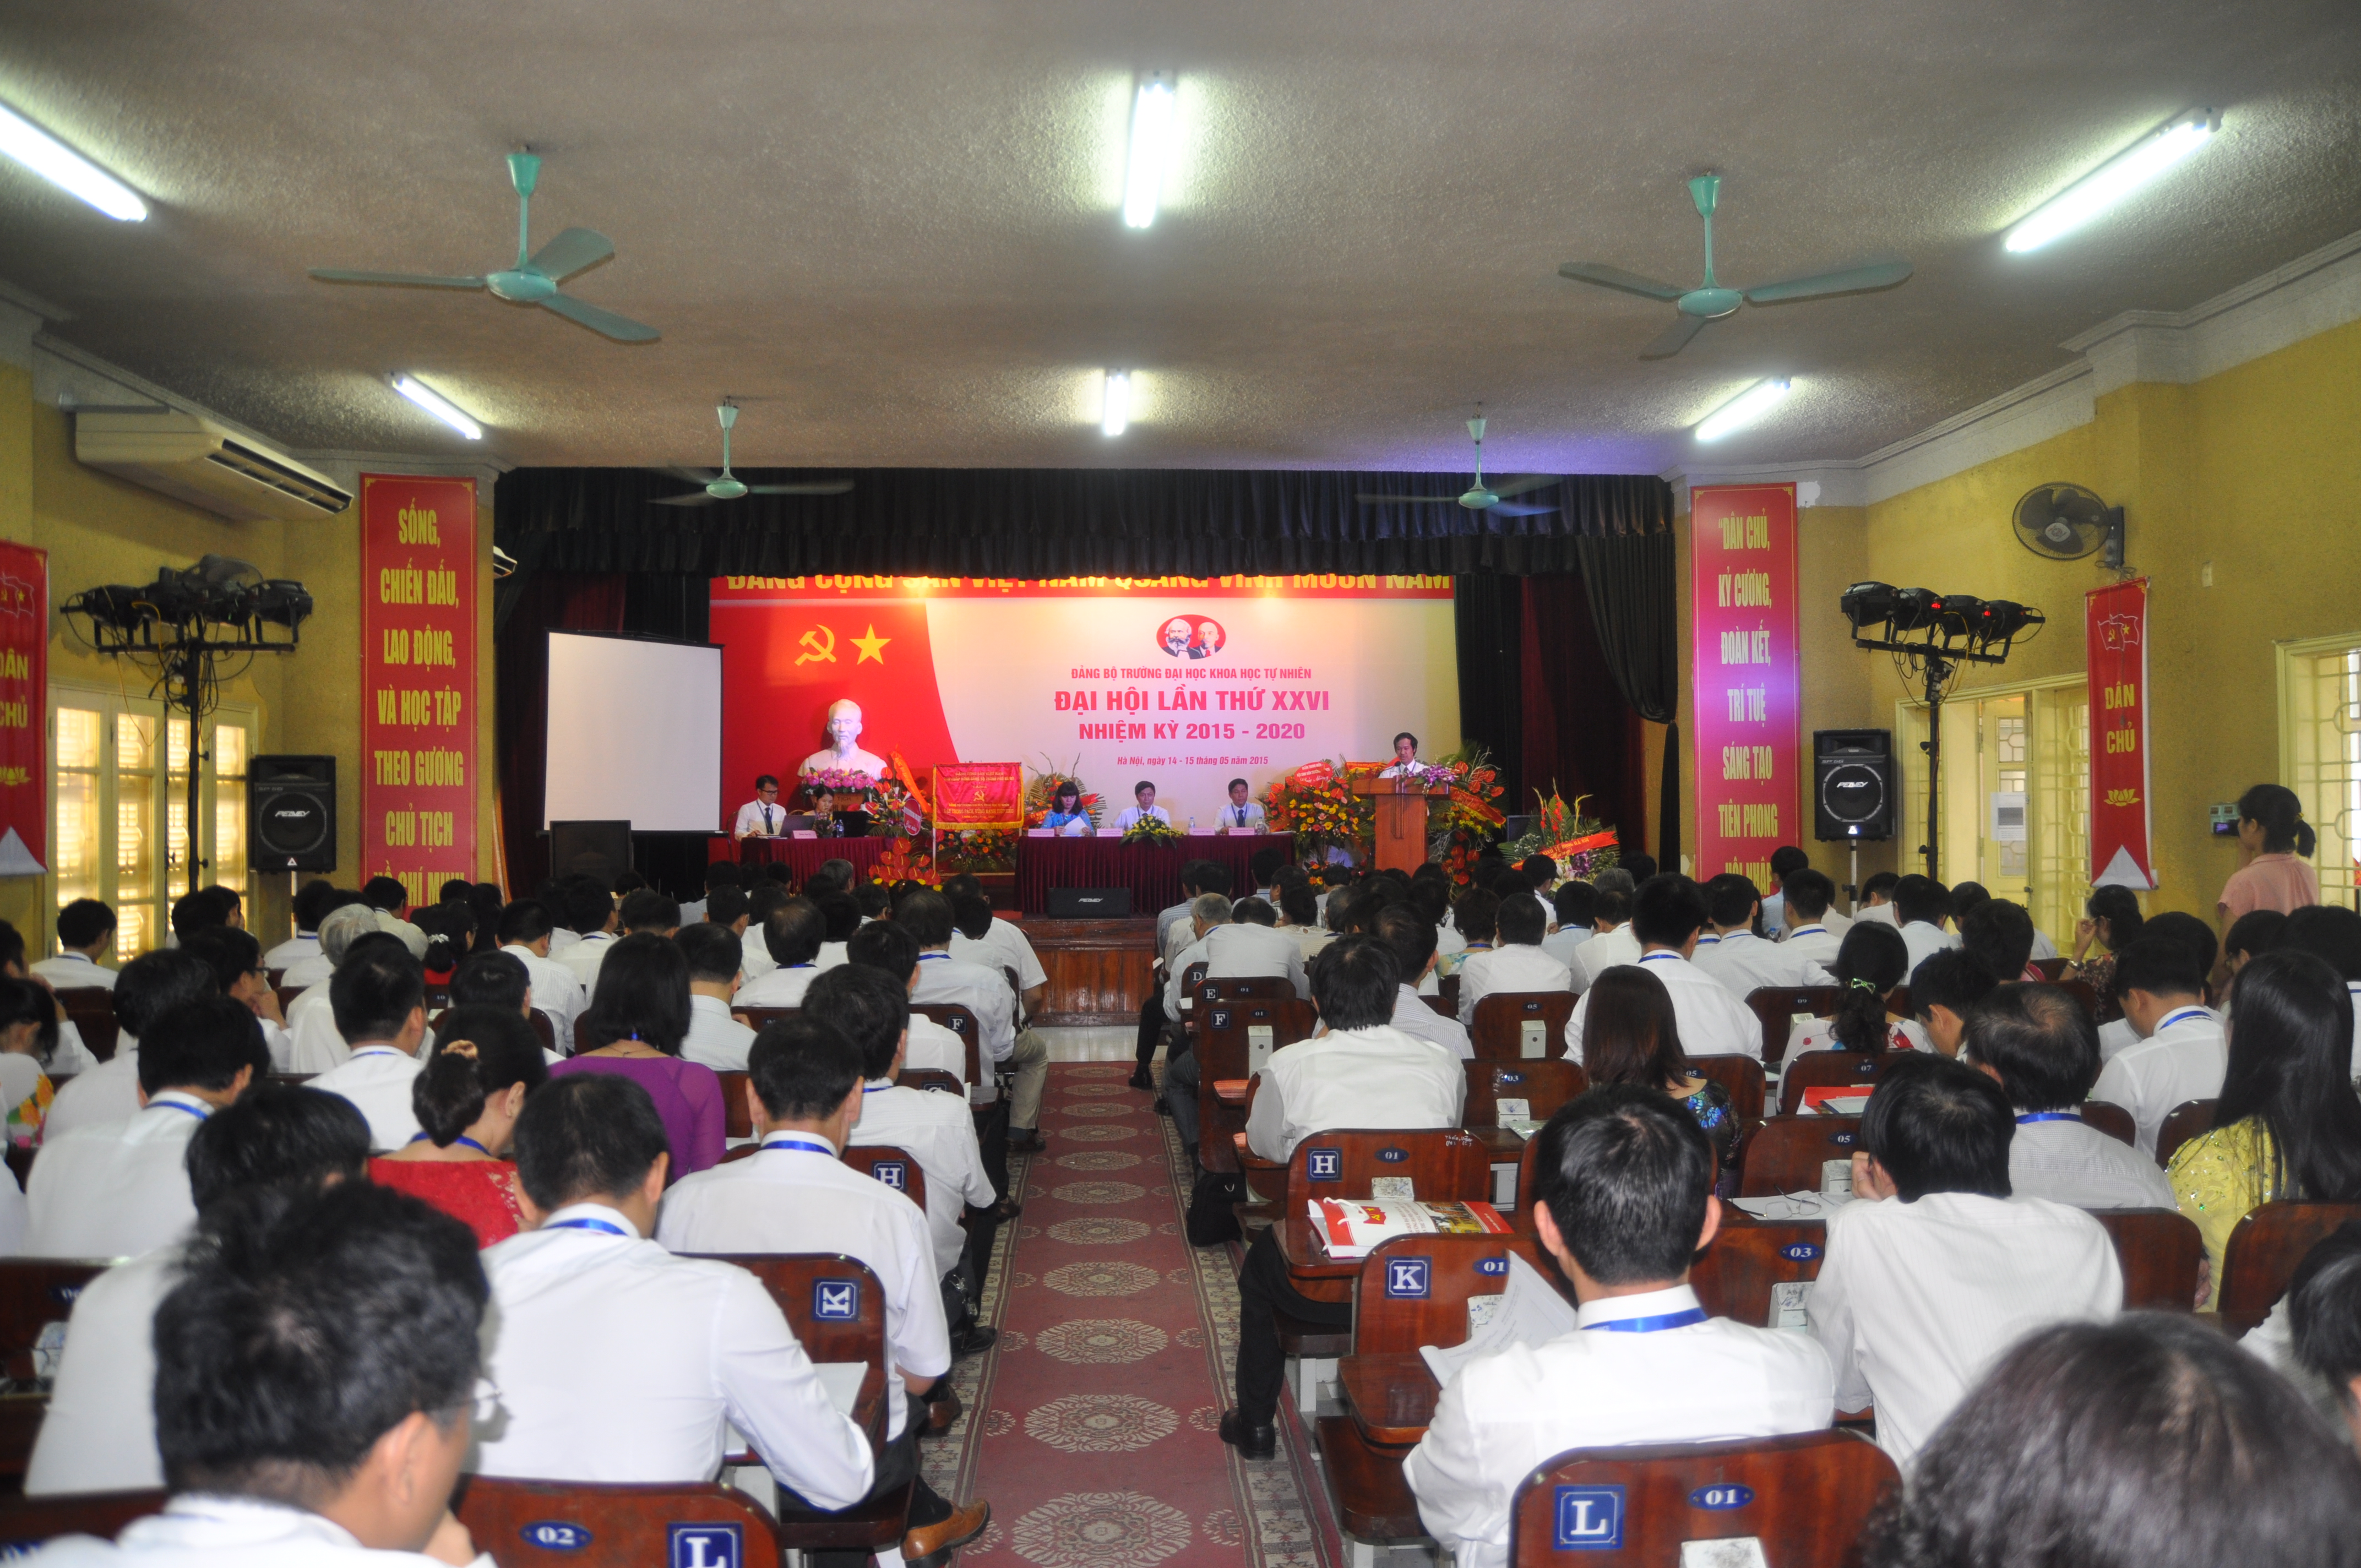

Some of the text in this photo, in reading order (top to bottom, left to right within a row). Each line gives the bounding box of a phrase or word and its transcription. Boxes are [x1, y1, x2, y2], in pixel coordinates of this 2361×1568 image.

[399, 498, 440, 548] SỐNG,
[1746, 508, 1770, 551] CHỦ,
[380, 558, 459, 608] CHIẾN ĐẤU,
[1718, 566, 1771, 609] KỶ CƯƠNG,
[384, 624, 455, 672] LAO ĐỘNG,
[1721, 619, 1771, 666] ĐOÀN KẾT,
[1071, 665, 1312, 681] ĐẢNG BỘ TRƯỜNG ĐẠI HỌC KHOA HỌC TỰ NHIÊN
[377, 684, 461, 732] VÀ HỌC TẬP
[1054, 684, 1329, 715] ĐẠI HỘI LẦN THỨ XXVI
[1727, 683, 1766, 727] TRÍ TUỆ
[2105, 681, 2135, 709] DÂN
[1079, 720, 1146, 743] NHIỆM
[1154, 720, 1179, 739] KỲ
[1186, 723, 1235, 739] 2015
[1256, 723, 1305, 739] 2020
[2107, 721, 2135, 754] CHỦ
[374, 746, 464, 786] THEO GƯƠNG
[1117, 756, 1127, 765] Hà
[1129, 756, 1144, 766] Nội,
[1147, 756, 1166, 766] ngày
[1185, 756, 1194, 765] 15
[1196, 756, 1217, 766] tháng
[1220, 756, 1229, 765] 05
[1231, 756, 1247, 765] năm
[1249, 756, 1269, 765] 2015
[1723, 741, 1772, 786] SÁNG TẠO
[386, 803, 453, 853] CHỦ TỊCH
[1718, 798, 1778, 837] TIÊN PHONG
[1193, 972, 1202, 981] D
[1206, 989, 1216, 999] E
[951, 1019, 962, 1030] F
[1215, 1014, 1225, 1025] F
[1837, 1135, 1851, 1143] 05
[878, 1167, 901, 1187] H
[1313, 1155, 1335, 1174] H
[1790, 1247, 1812, 1257] 03
[1393, 1266, 1422, 1289] K
[1483, 1261, 1505, 1272] 01
[822, 1287, 850, 1314] K
[1705, 1489, 1737, 1505] 01
[1570, 1500, 1608, 1536] L
[536, 1526, 575, 1545] 02
[686, 1537, 727, 1568] L
